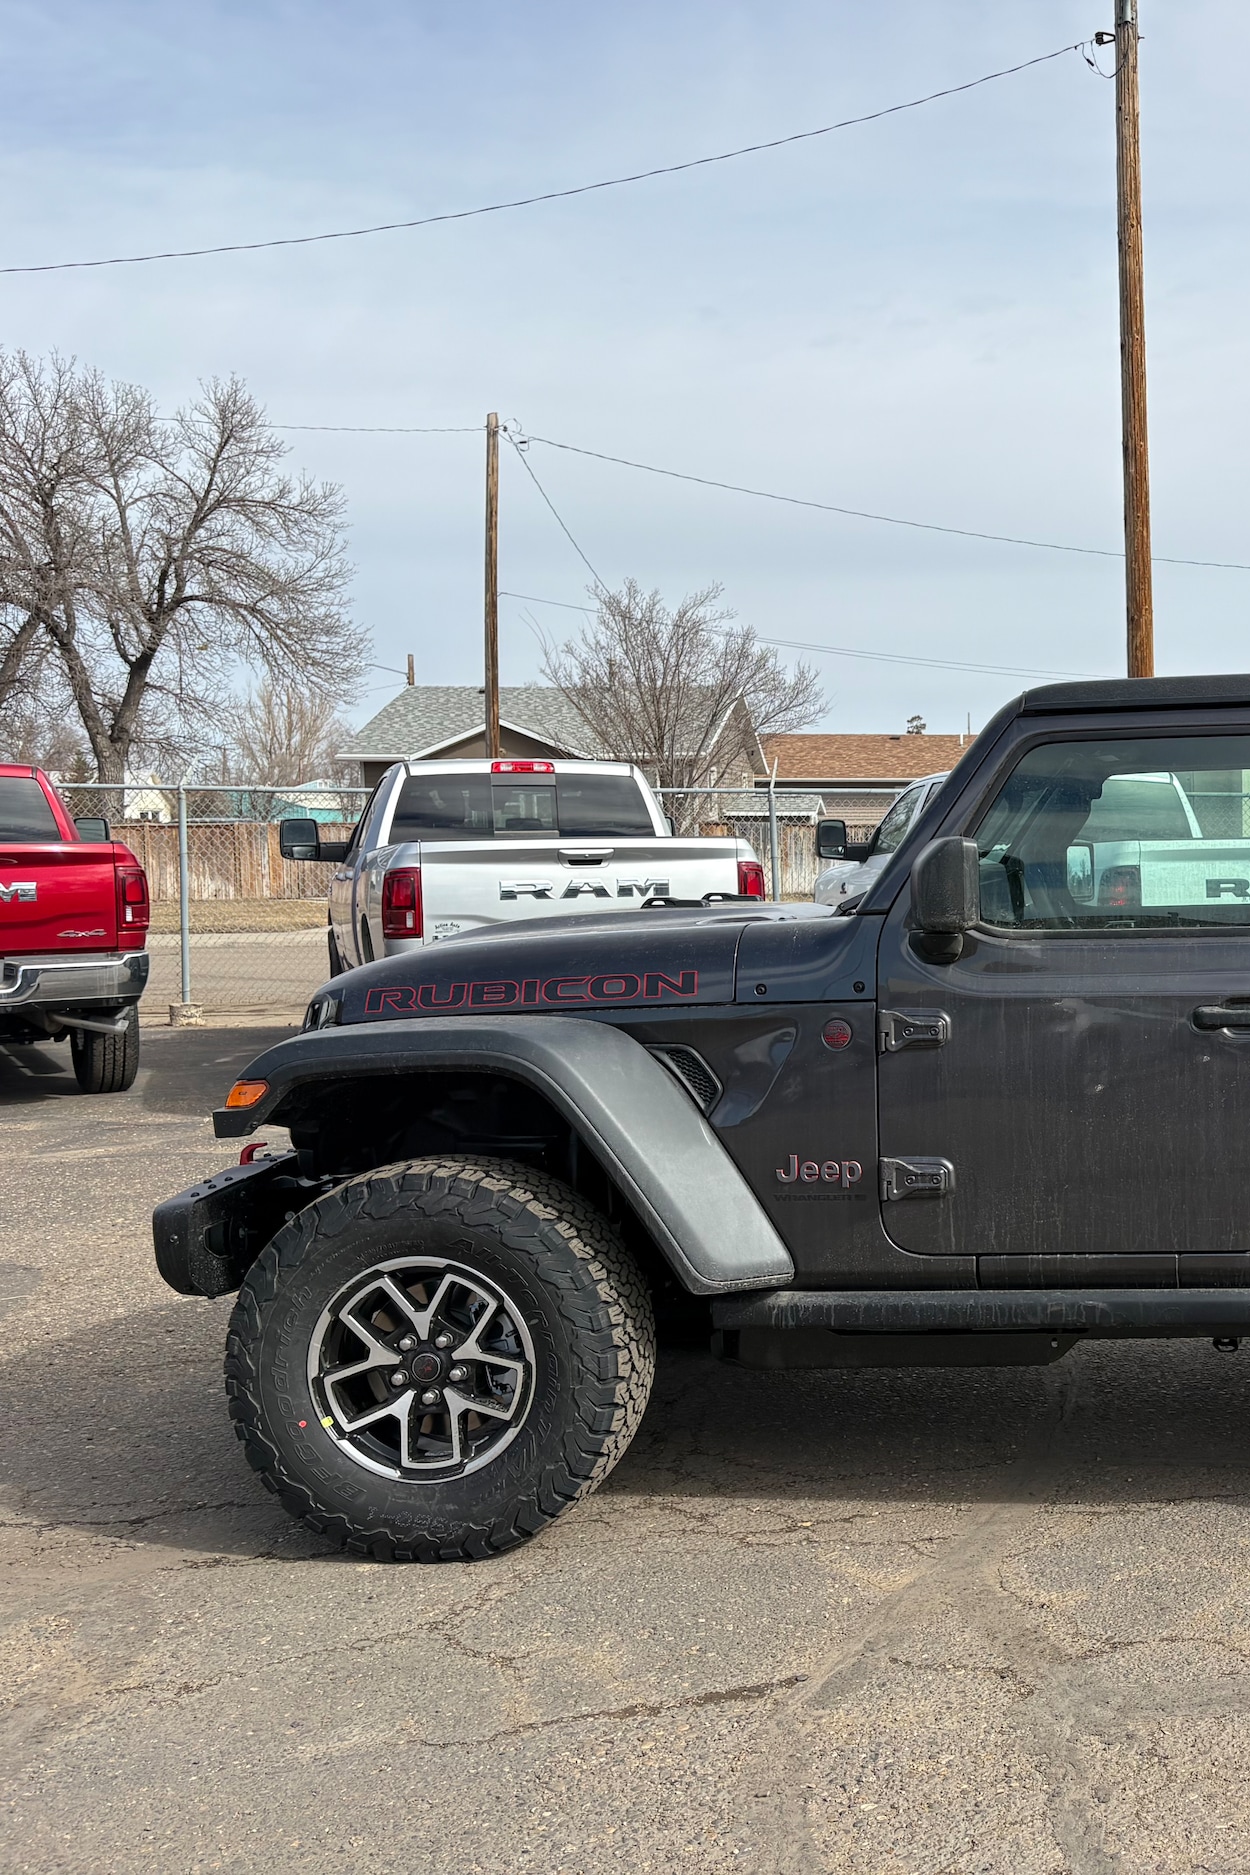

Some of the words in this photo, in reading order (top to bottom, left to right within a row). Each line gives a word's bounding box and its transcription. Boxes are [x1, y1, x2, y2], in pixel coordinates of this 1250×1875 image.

[499, 878, 670, 900] RAM
[57, 929, 107, 937] 4x4
[364, 970, 698, 1013] RUBICON
[775, 1154, 863, 1188] Jeep
[773, 1194, 852, 1202] WRANGLER
[270, 1285, 368, 1502] BFGoodrich
